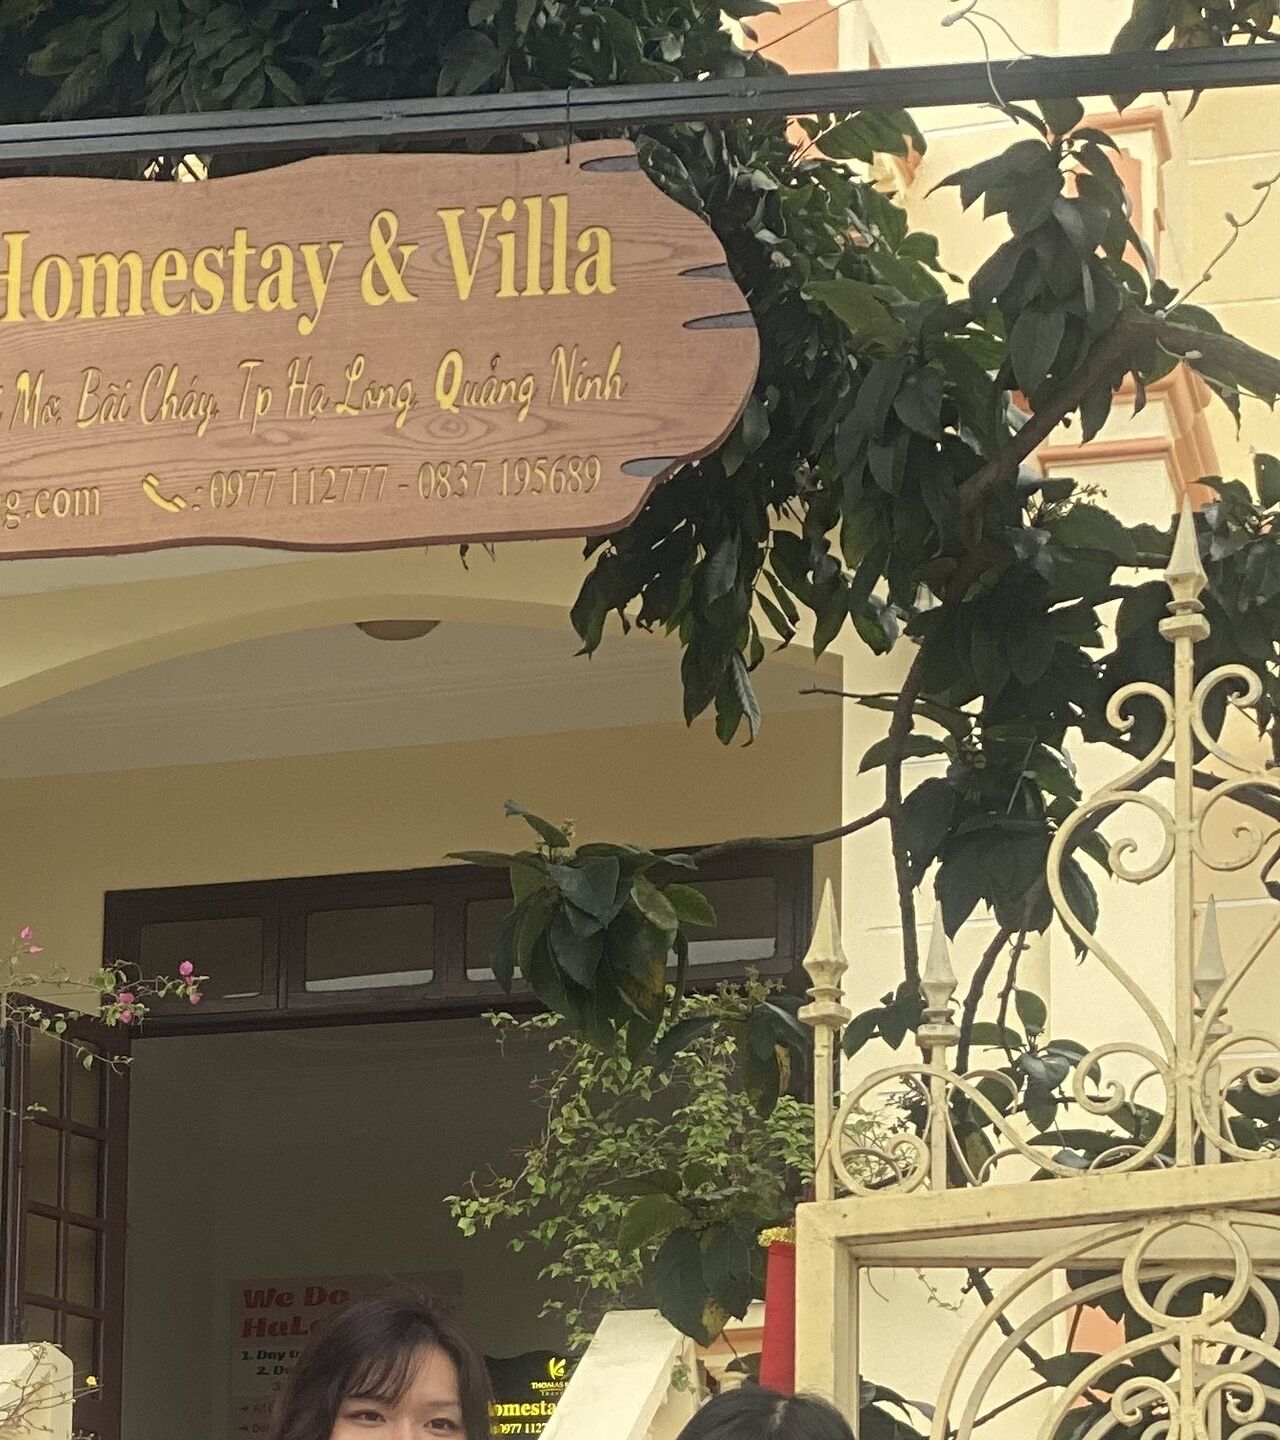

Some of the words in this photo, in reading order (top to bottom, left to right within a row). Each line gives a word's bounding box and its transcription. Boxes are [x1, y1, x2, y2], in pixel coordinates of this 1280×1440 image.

[360, 209, 419, 306] &
[437, 194, 618, 300] Villa
[77, 366, 132, 428] Bãi
[238, 359, 273, 435] Tp
[285, 356, 330, 425] Hạ
[435, 348, 537, 423] Quảng
[548, 341, 628, 407] Ninh
[208, 468, 278, 509] 0977
[289, 463, 390, 506] 112777
[417, 459, 488, 501] 0837
[499, 454, 603, 496] 195689
[243, 1289, 295, 1309] We
[256, 1350, 287, 1362] Day
[530, 1382, 562, 1390] THOMAS
